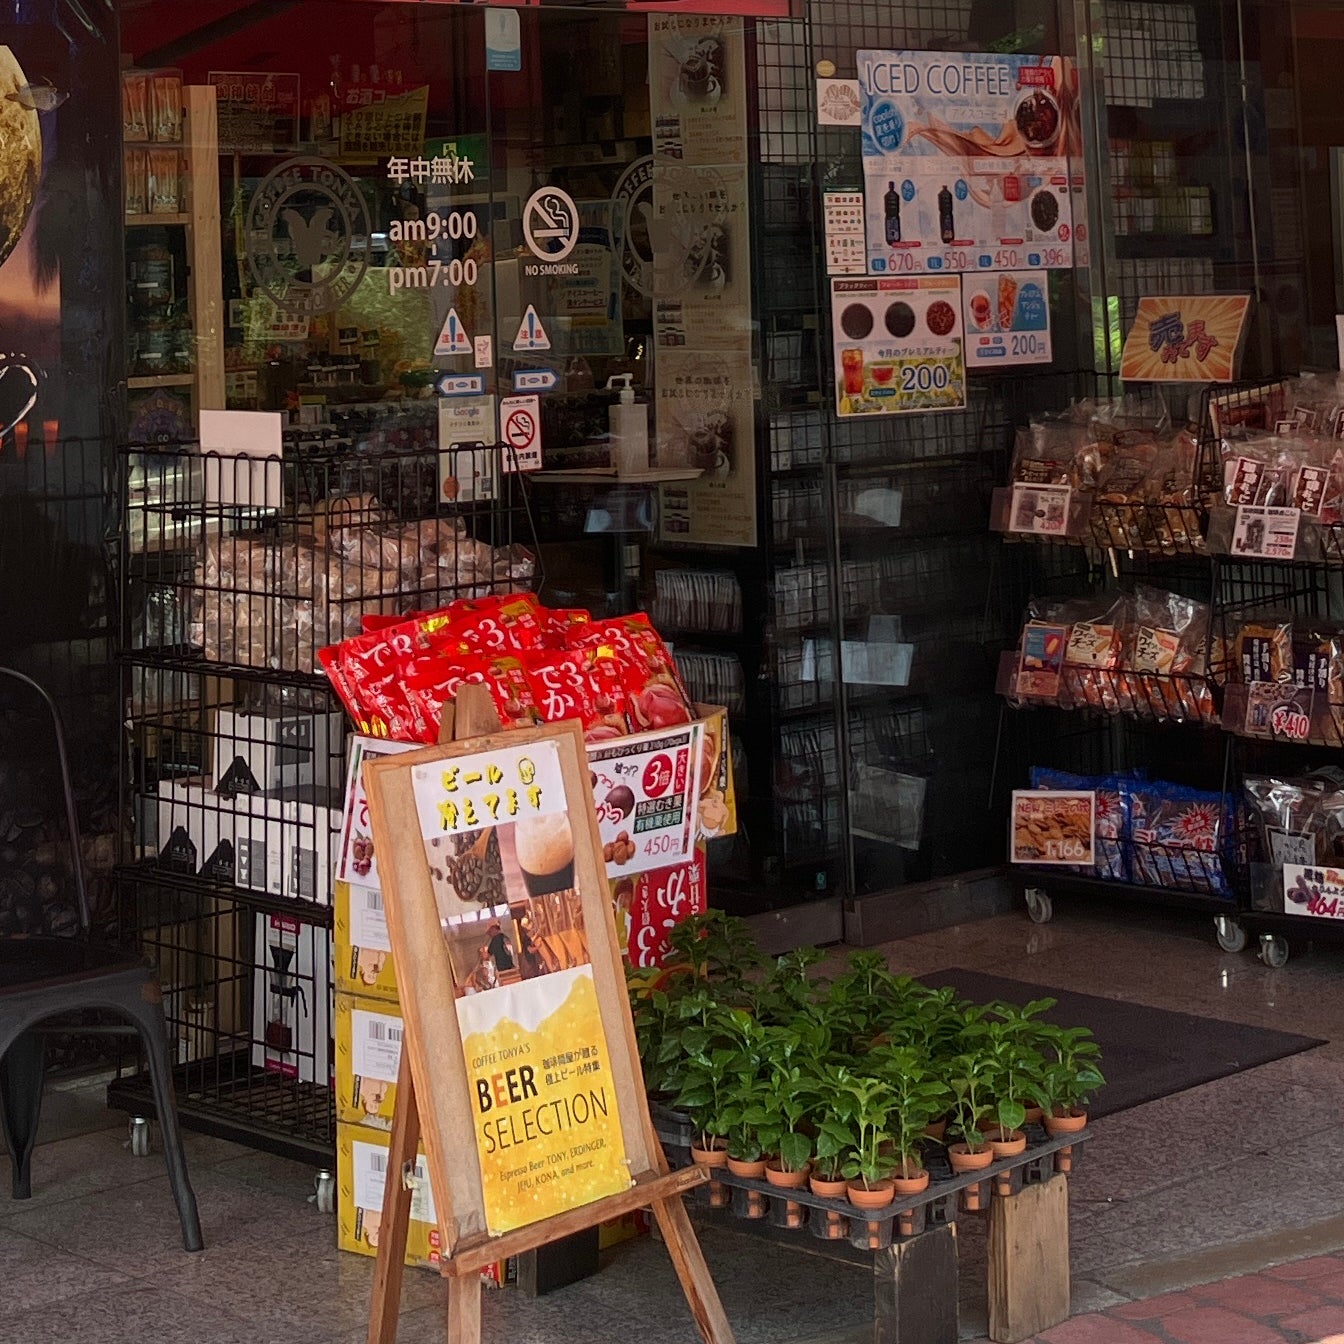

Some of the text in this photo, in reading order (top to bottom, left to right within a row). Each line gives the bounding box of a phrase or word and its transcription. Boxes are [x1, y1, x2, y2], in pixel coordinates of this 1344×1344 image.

[866, 62, 920, 94] ICED
[926, 64, 1010, 96] COFFEE
[387, 155, 475, 185] 年中無休
[389, 211, 477, 241] am9:00
[389, 258, 478, 296] pm7:00
[525, 263, 579, 276] NO SMOKING
[1011, 334, 1047, 356] 200円
[902, 365, 948, 391] 200
[453, 407, 480, 419] Google
[1272, 710, 1310, 739] ¥410
[441, 763, 505, 793] ビール
[676, 752, 688, 791] 大きい
[643, 834, 681, 857] 450円
[472, 1042, 532, 1070] COFFEE TONYA'S
[476, 1064, 539, 1114] BEER
[483, 1086, 609, 1155] SELECTION
[499, 1165, 528, 1183] Espresso
[529, 1159, 545, 1174] Beer
[561, 1165, 575, 1178] and
